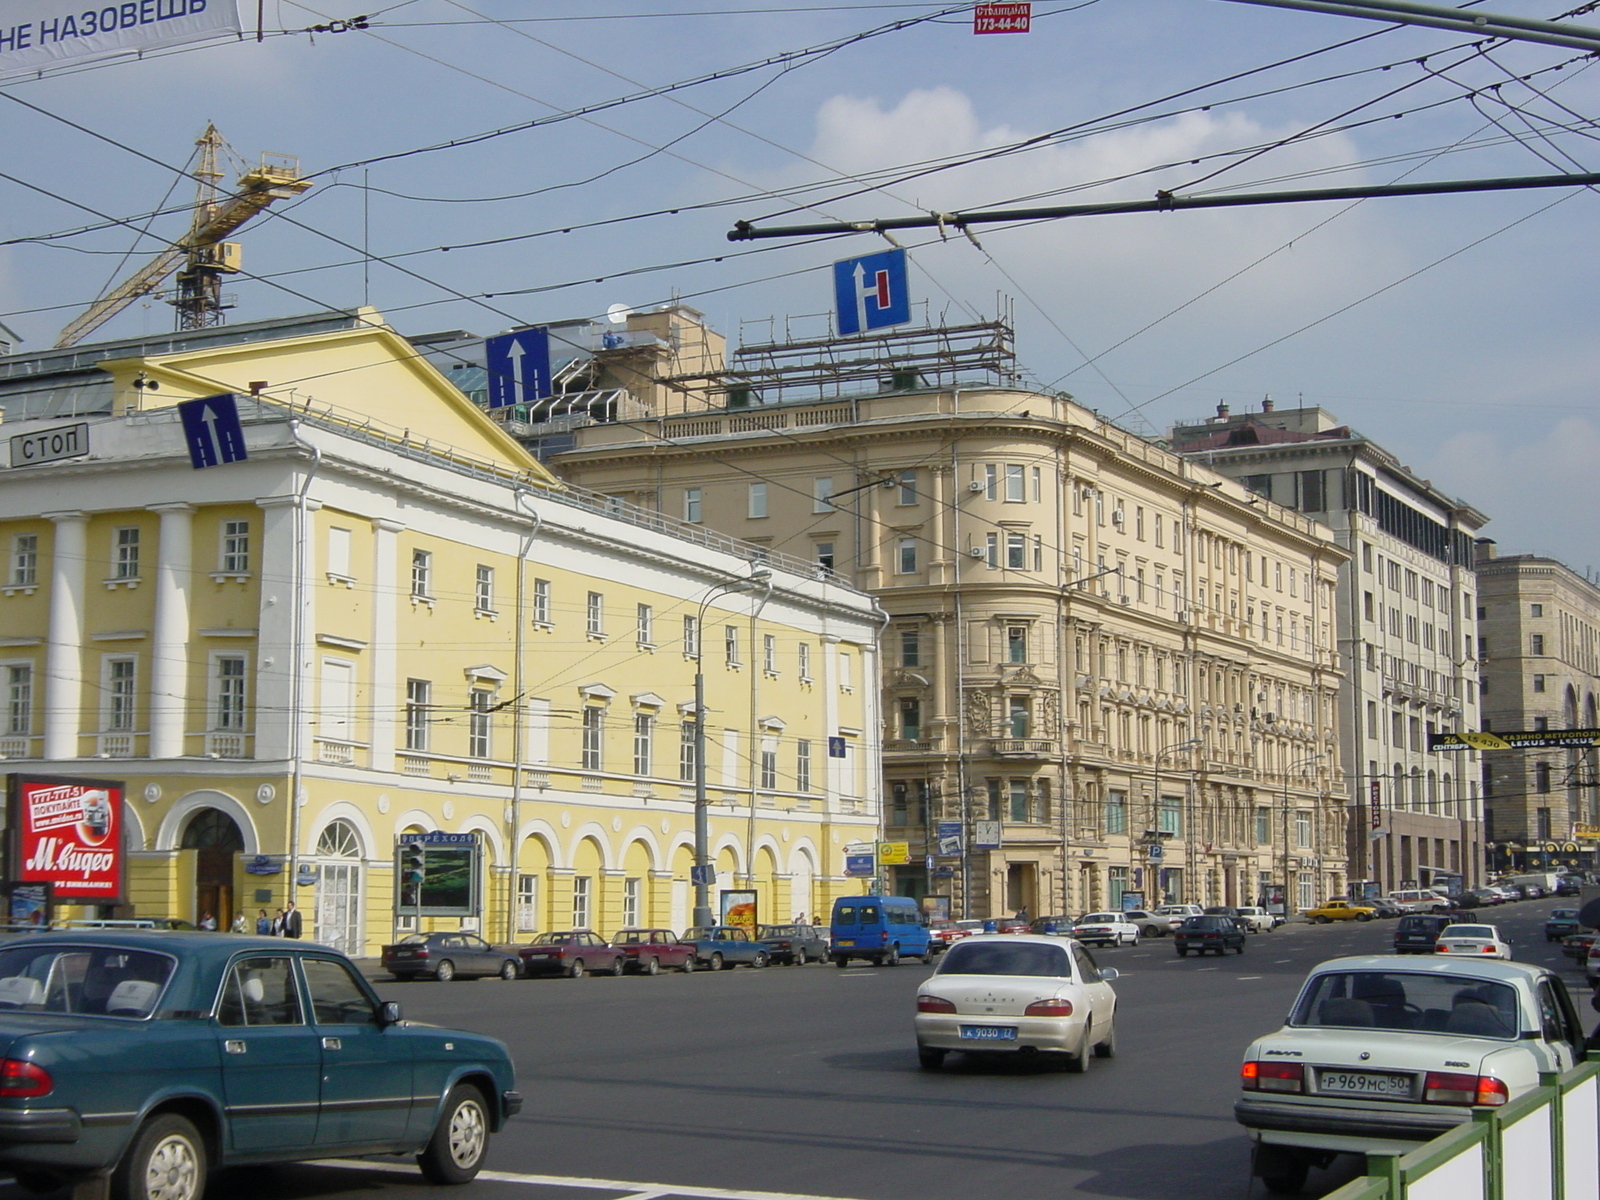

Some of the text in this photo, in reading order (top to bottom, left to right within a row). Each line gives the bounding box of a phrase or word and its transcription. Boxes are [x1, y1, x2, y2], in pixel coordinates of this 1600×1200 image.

[977, 17, 1028, 30] 173-44-40
[0, 23, 32, 51] НЕ
[23, 431, 78, 459] СТОП
[1444, 736, 1458, 744] 26
[1502, 733, 1542, 741] КАЗИНО
[1559, 737, 1594, 745] LEXUS
[1432, 743, 1469, 751] СЕНТЯБРЯ
[1481, 739, 1500, 748] 430
[34, 799, 81, 816] ПОКУПАЙТЕ
[1372, 786, 1380, 826] РЕСТОРАН
[409, 835, 466, 843] ПЕРЕХОД
[1152, 846, 1160, 856] P
[976, 1029, 998, 1037] 9030
[1390, 1077, 1405, 1088] 50
